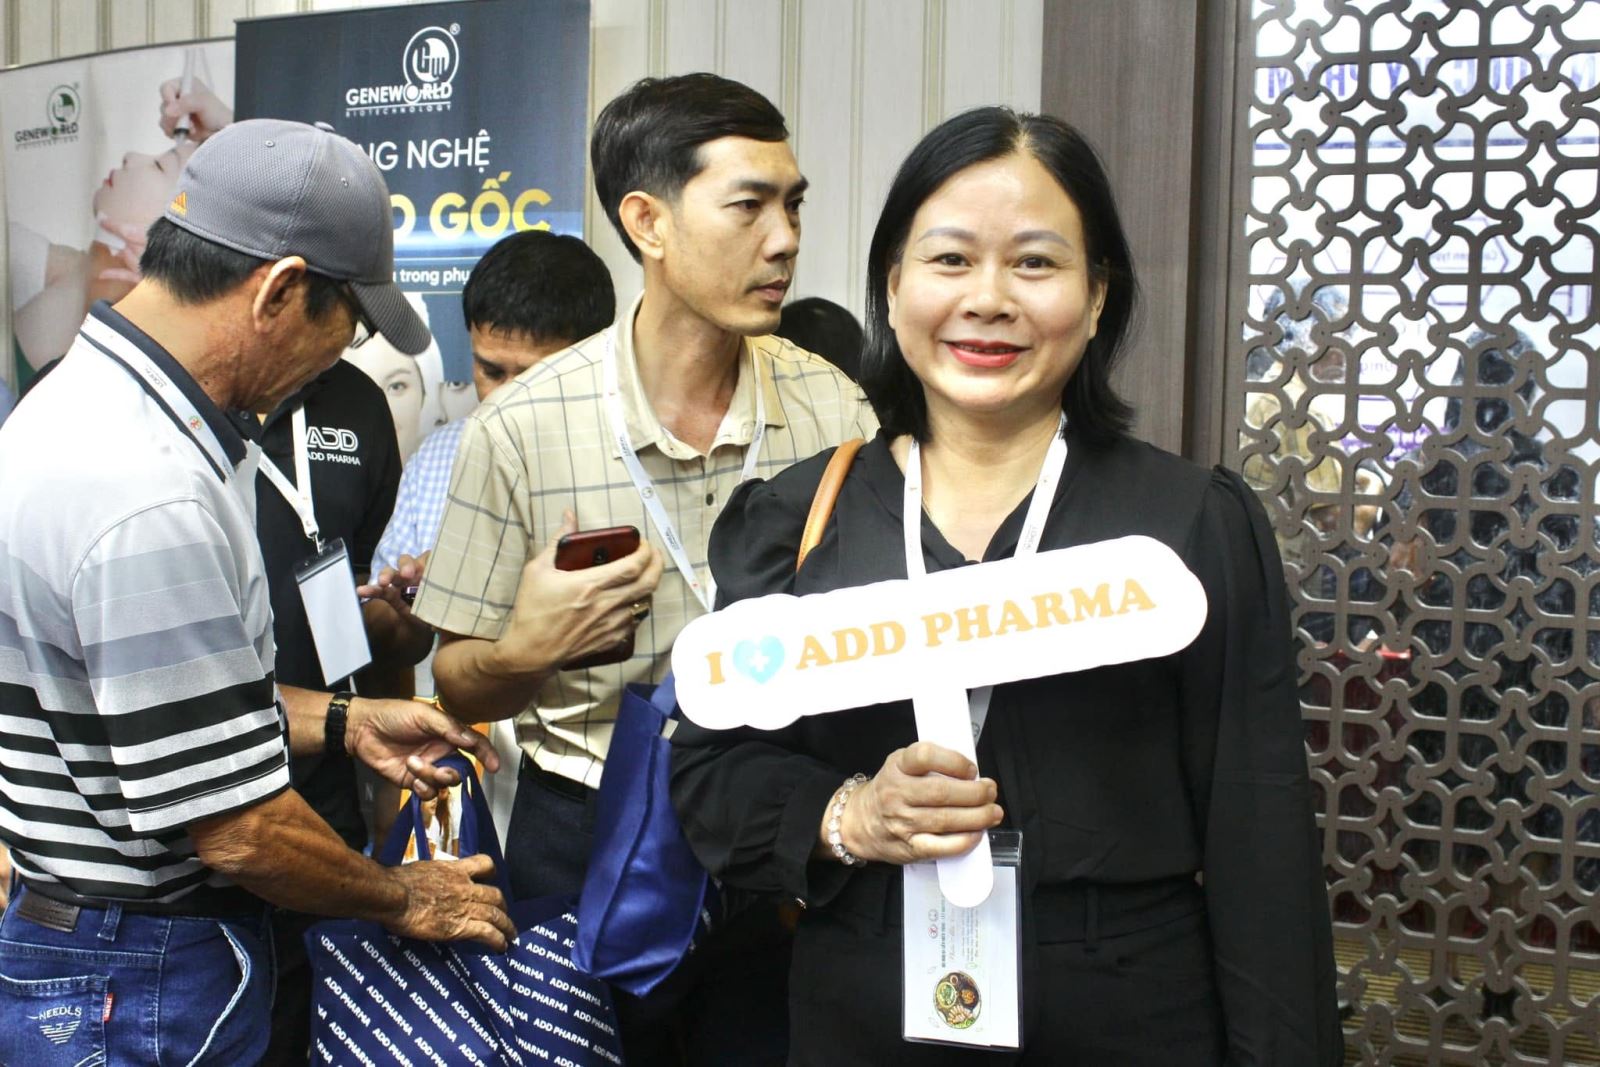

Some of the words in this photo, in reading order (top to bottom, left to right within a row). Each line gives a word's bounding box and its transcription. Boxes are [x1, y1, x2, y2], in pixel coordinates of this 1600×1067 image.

[345, 81, 453, 106] GENEWORLD
[407, 129, 491, 173] NGHỆ
[429, 171, 552, 240] GỐC
[400, 270, 440, 286] trong
[326, 453, 361, 466] PHARMA
[705, 651, 726, 685] I
[796, 620, 906, 670] ADD
[921, 578, 1157, 647] PHARMA
[526, 942, 546, 956] ADD
[333, 949, 365, 985] PHARMA
[361, 940, 380, 959] ADD
[377, 956, 408, 991] PHARMA
[509, 958, 544, 982] PHARMA
[419, 965, 450, 1000] PHARMA
[473, 981, 490, 1000] ADD
[549, 977, 570, 992] ADD
[324, 976, 343, 996] ADD
[340, 992, 371, 1028] PHARMA
[366, 985, 385, 1004] ADD
[381, 1000, 413, 1036] PHARMA
[512, 982, 532, 998] ADD
[531, 991, 569, 1013] PHARMA
[409, 991, 428, 1011] ADD
[425, 1007, 457, 1043] PHARMA
[451, 1000, 470, 1020] ADD
[467, 1016, 498, 1051] PHARMA
[573, 1009, 592, 1023] ADD
[329, 1021, 347, 1041] ADD
[372, 1028, 391, 1047] ADD
[533, 1018, 553, 1032] ADD
[553, 1026, 590, 1048] PHARMA
[414, 1036, 433, 1056] ADD
[458, 1043, 477, 1063] ADD
